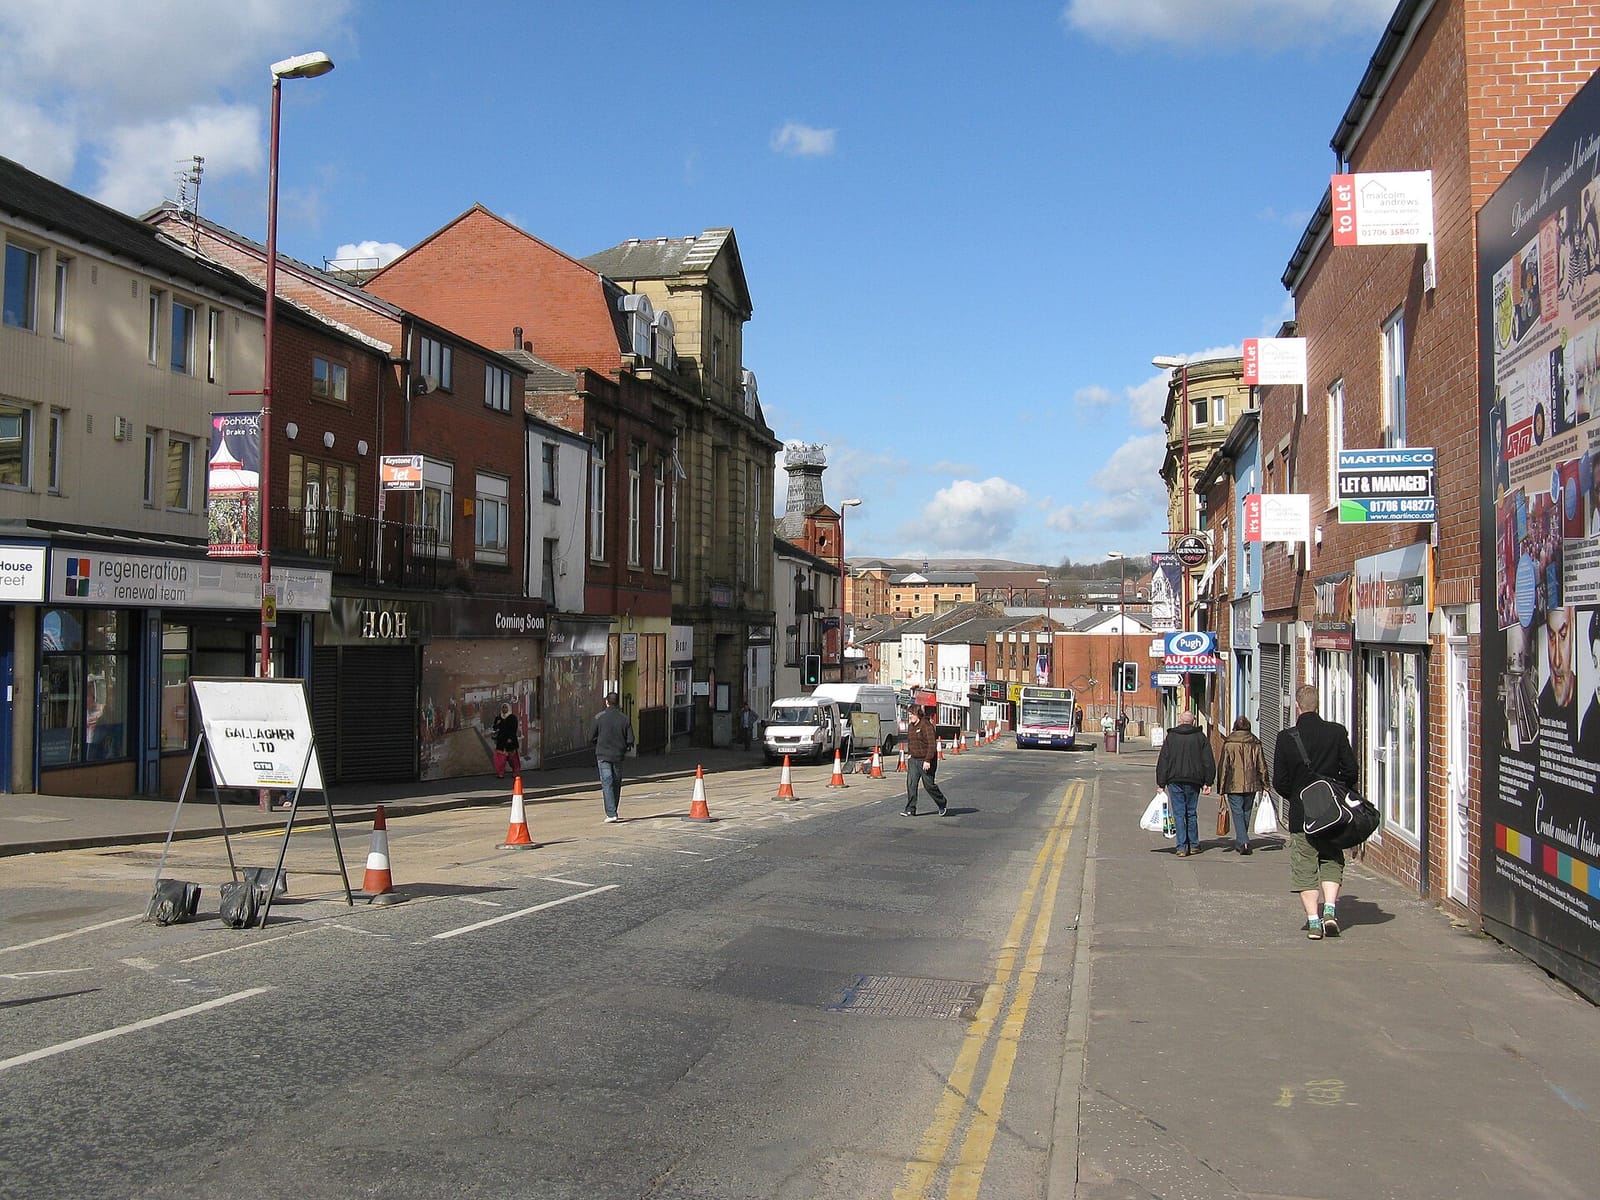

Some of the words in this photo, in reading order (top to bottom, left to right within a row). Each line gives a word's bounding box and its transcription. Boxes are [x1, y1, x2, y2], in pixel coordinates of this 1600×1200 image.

[1335, 184, 1352, 212] Let
[1365, 192, 1406, 200] malcolm
[1337, 215, 1353, 234] to
[1361, 229, 1388, 237] 01706
[1246, 345, 1257, 362] Let
[1340, 454, 1434, 465] MARTIN&CO
[1341, 477, 1360, 493] LET
[1360, 476, 1371, 493] &
[1371, 475, 1426, 492] MANAGED
[1249, 501, 1259, 518] Let
[1369, 500, 1398, 512] 01706
[99, 560, 187, 583] regeneration
[114, 583, 158, 600] renewal
[161, 585, 187, 601] team
[1404, 581, 1422, 602] Design
[495, 612, 525, 633] Coming
[526, 613, 545, 629] Soon
[1180, 638, 1202, 650] Pugh
[1164, 655, 1217, 665] AUCTION
[224, 727, 295, 741] GALLAGHER
[252, 742, 275, 753] LTD
[1535, 787, 1555, 838] Create
[1554, 817, 1582, 850] musical
